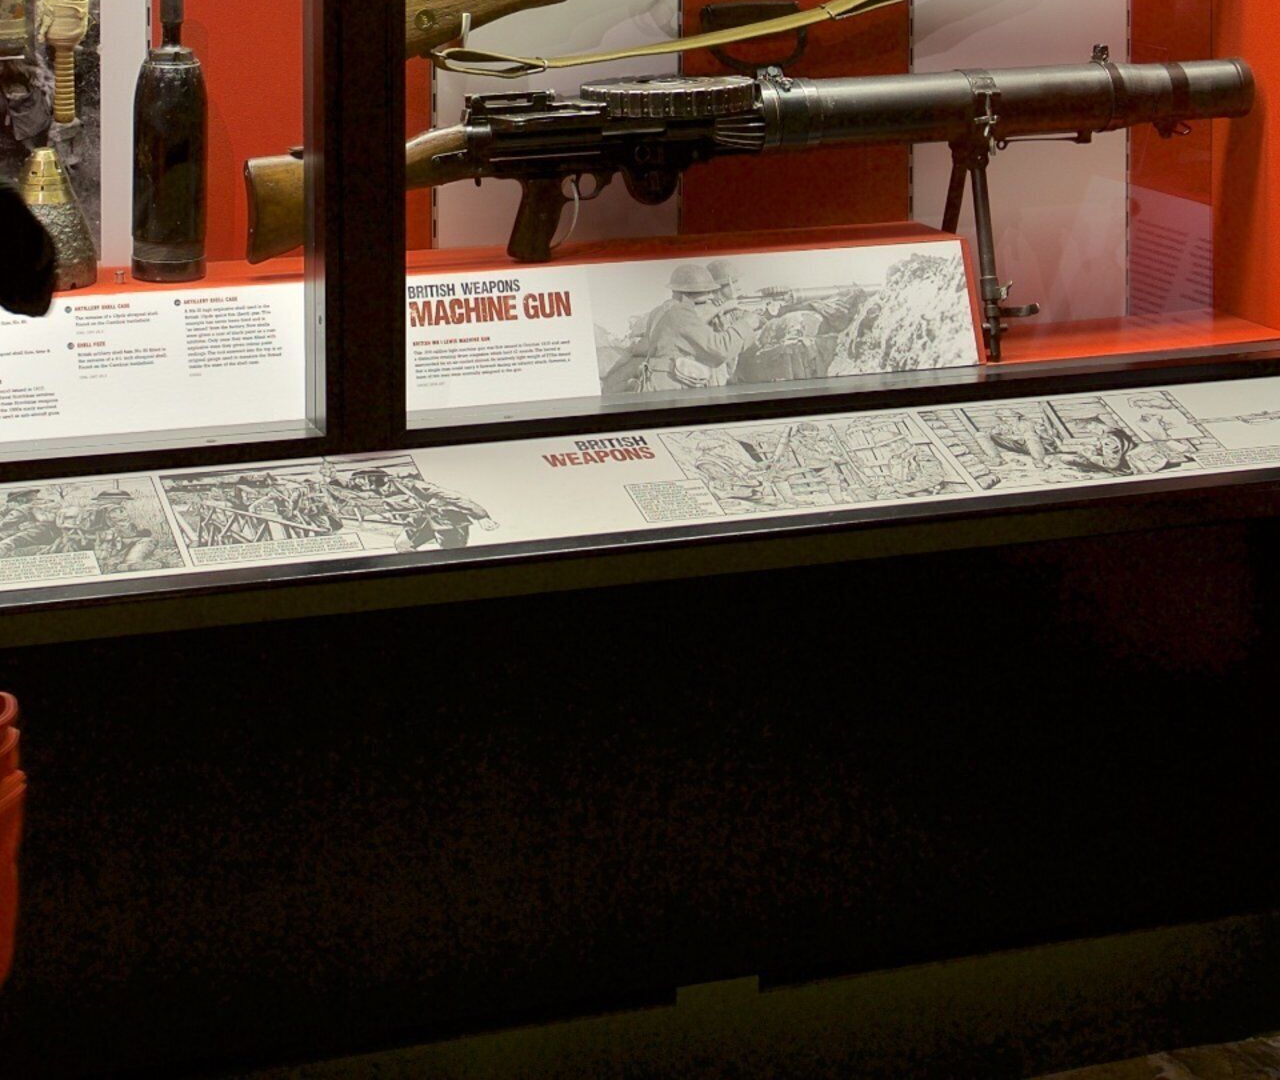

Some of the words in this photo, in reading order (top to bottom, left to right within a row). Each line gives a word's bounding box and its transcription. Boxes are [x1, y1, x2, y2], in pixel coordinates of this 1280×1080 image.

[408, 284, 455, 299] BRITISH
[461, 279, 520, 295] WEAPONS
[409, 295, 518, 327] MACHINE
[523, 291, 571, 319] GUN
[575, 436, 647, 451] BRITISH
[542, 447, 655, 468] WEAPONS
